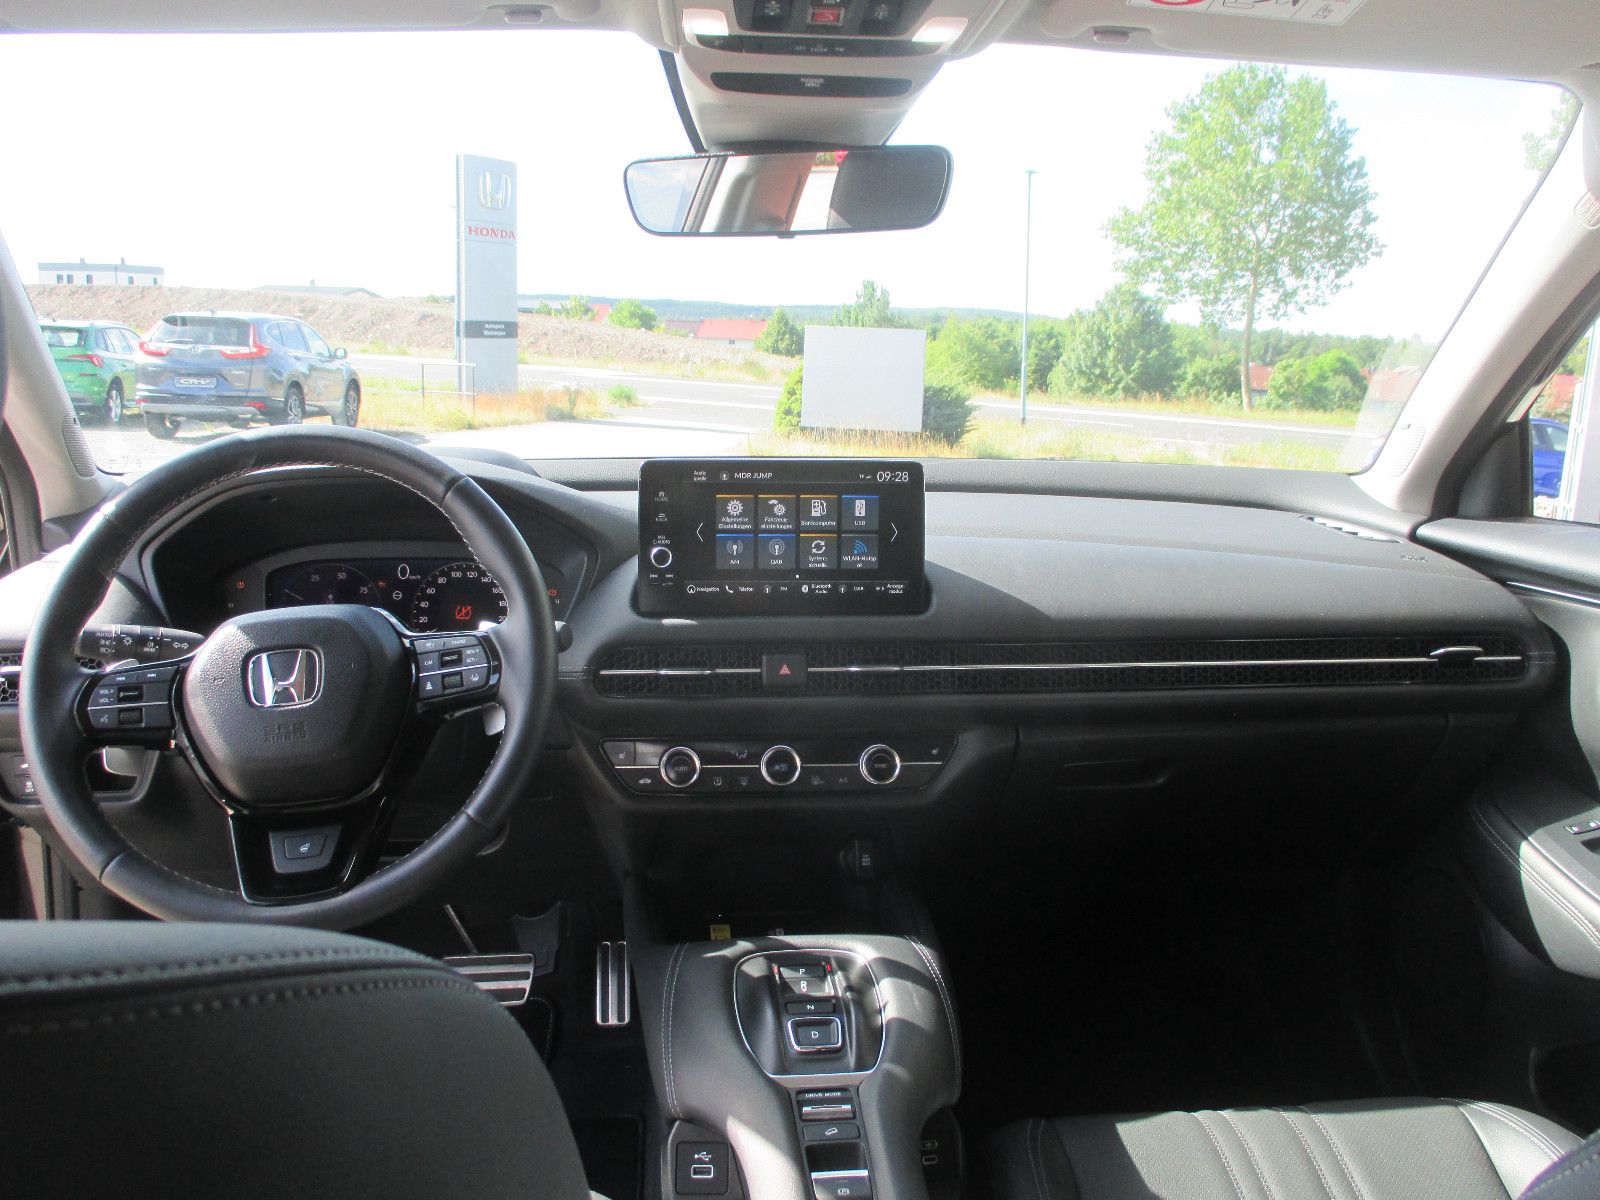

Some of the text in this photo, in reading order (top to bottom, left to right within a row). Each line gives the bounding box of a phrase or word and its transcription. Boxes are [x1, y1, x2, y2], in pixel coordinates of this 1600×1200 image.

[468, 225, 517, 240] HONDA
[876, 471, 909, 482] 09:28
[397, 563, 410, 580] 0
[311, 574, 320, 582] 25
[336, 572, 347, 580] 50
[359, 586, 368, 594] 75
[811, 1031, 819, 1039] D
